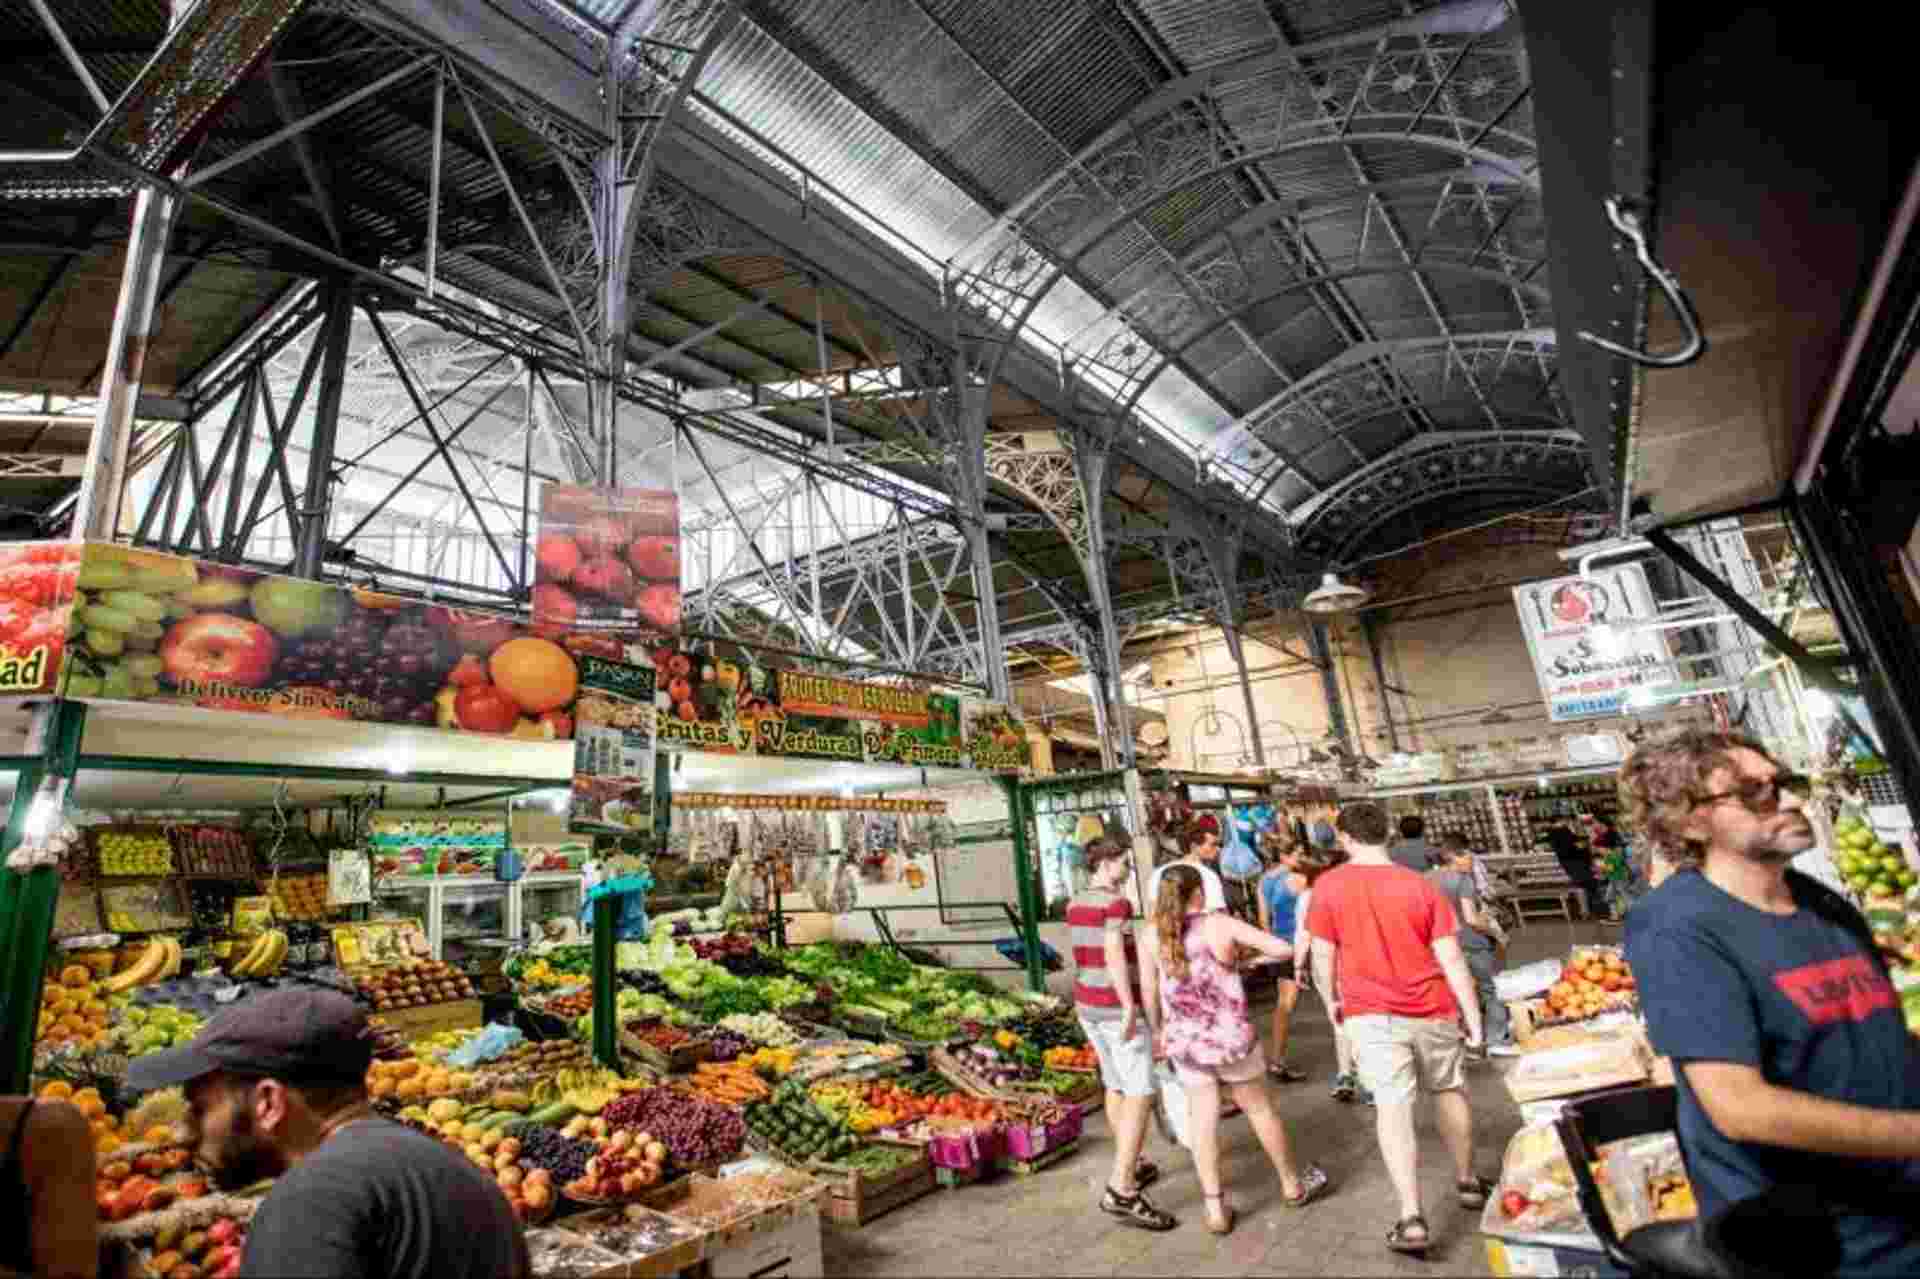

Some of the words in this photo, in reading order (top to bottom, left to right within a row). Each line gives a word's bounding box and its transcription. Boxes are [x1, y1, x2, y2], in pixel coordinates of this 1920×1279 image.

[0, 647, 44, 686] ad
[279, 687, 315, 708] Sin
[738, 728, 752, 751] y
[757, 718, 859, 754] Verduras
